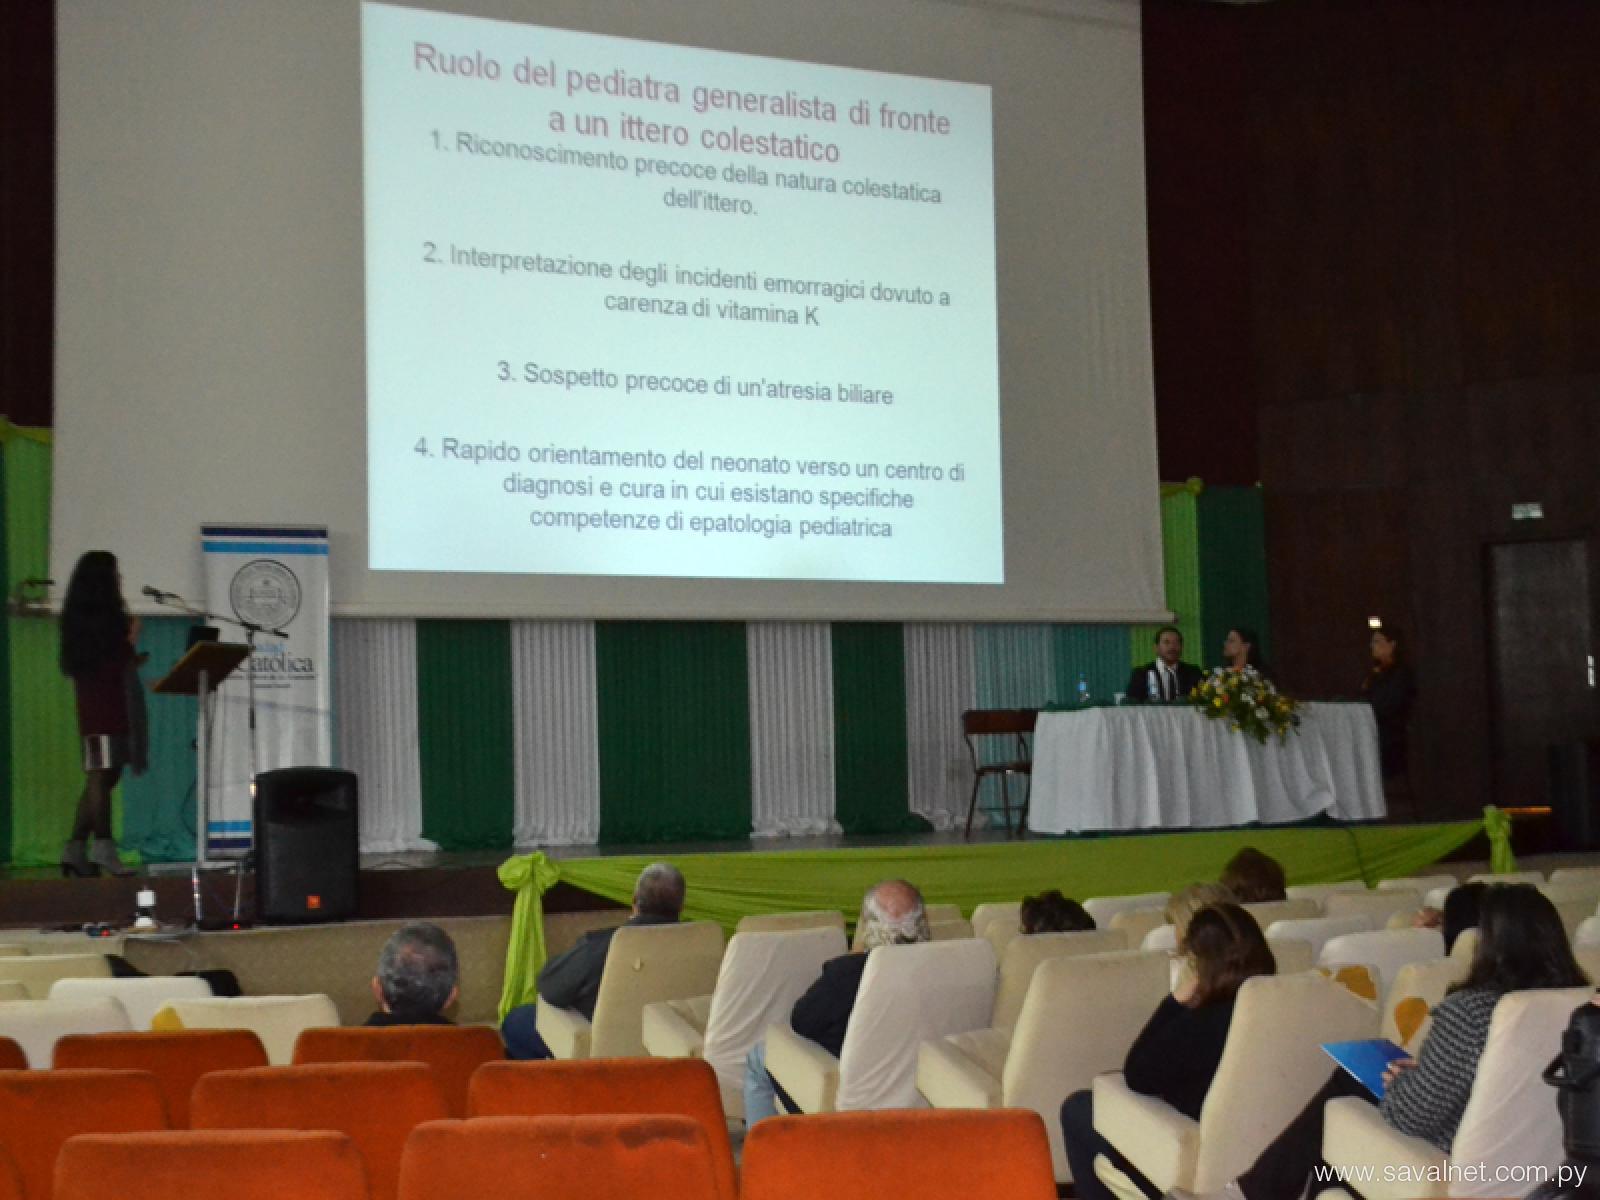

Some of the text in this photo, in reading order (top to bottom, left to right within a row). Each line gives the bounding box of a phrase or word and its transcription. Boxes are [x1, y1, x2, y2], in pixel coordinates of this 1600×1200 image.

[413, 41, 951, 135] Ruolo del pediatra generalista di fronte
[548, 111, 839, 163] a un ittero colestatico
[430, 129, 942, 204] 1. Riconoscimento precoce della natura colestatica
[663, 188, 758, 216] dell'ittero.
[423, 242, 951, 306] 2. Interpretazione degli incidenti emorragici dovuto a
[604, 292, 820, 325] carenza di vitamina K
[497, 361, 893, 404] 3. Sospetto precoce di un'atresia biliare
[414, 438, 965, 481] 4. Rapido orientamento del neonato verso un centro di
[503, 474, 914, 510] diagnosi e cura in cui esistano specifiche
[530, 509, 892, 538] competenze di epatologia pediatrica
